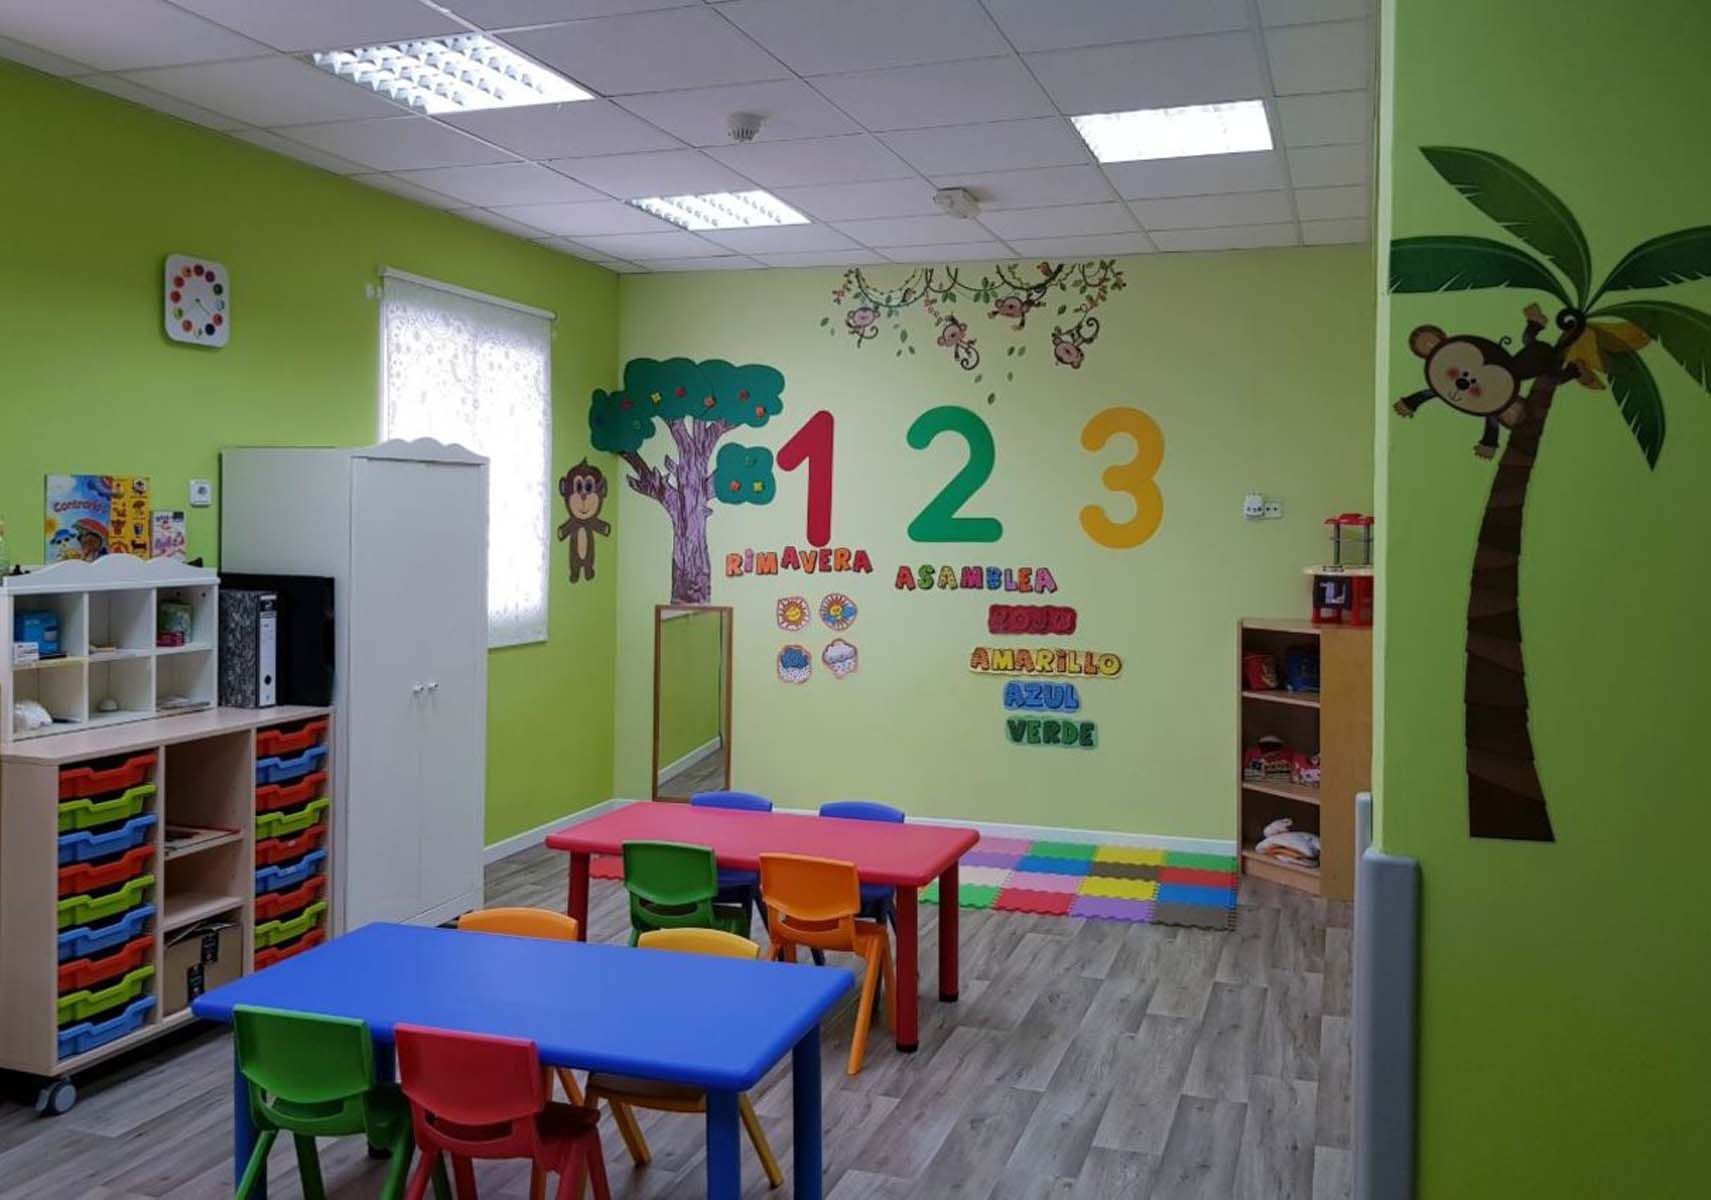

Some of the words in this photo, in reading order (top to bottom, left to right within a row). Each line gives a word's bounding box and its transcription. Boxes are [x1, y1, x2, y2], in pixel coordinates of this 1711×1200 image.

[777, 410, 834, 547] 1
[907, 406, 1003, 542] 2
[1079, 406, 1165, 549] 3
[725, 546, 873, 576] RIMAVERA
[895, 564, 1057, 593] ASAMBLEA
[970, 647, 1122, 676] AMARILLO
[1004, 682, 1080, 709] AZUL
[1006, 719, 1096, 747] VERDE
